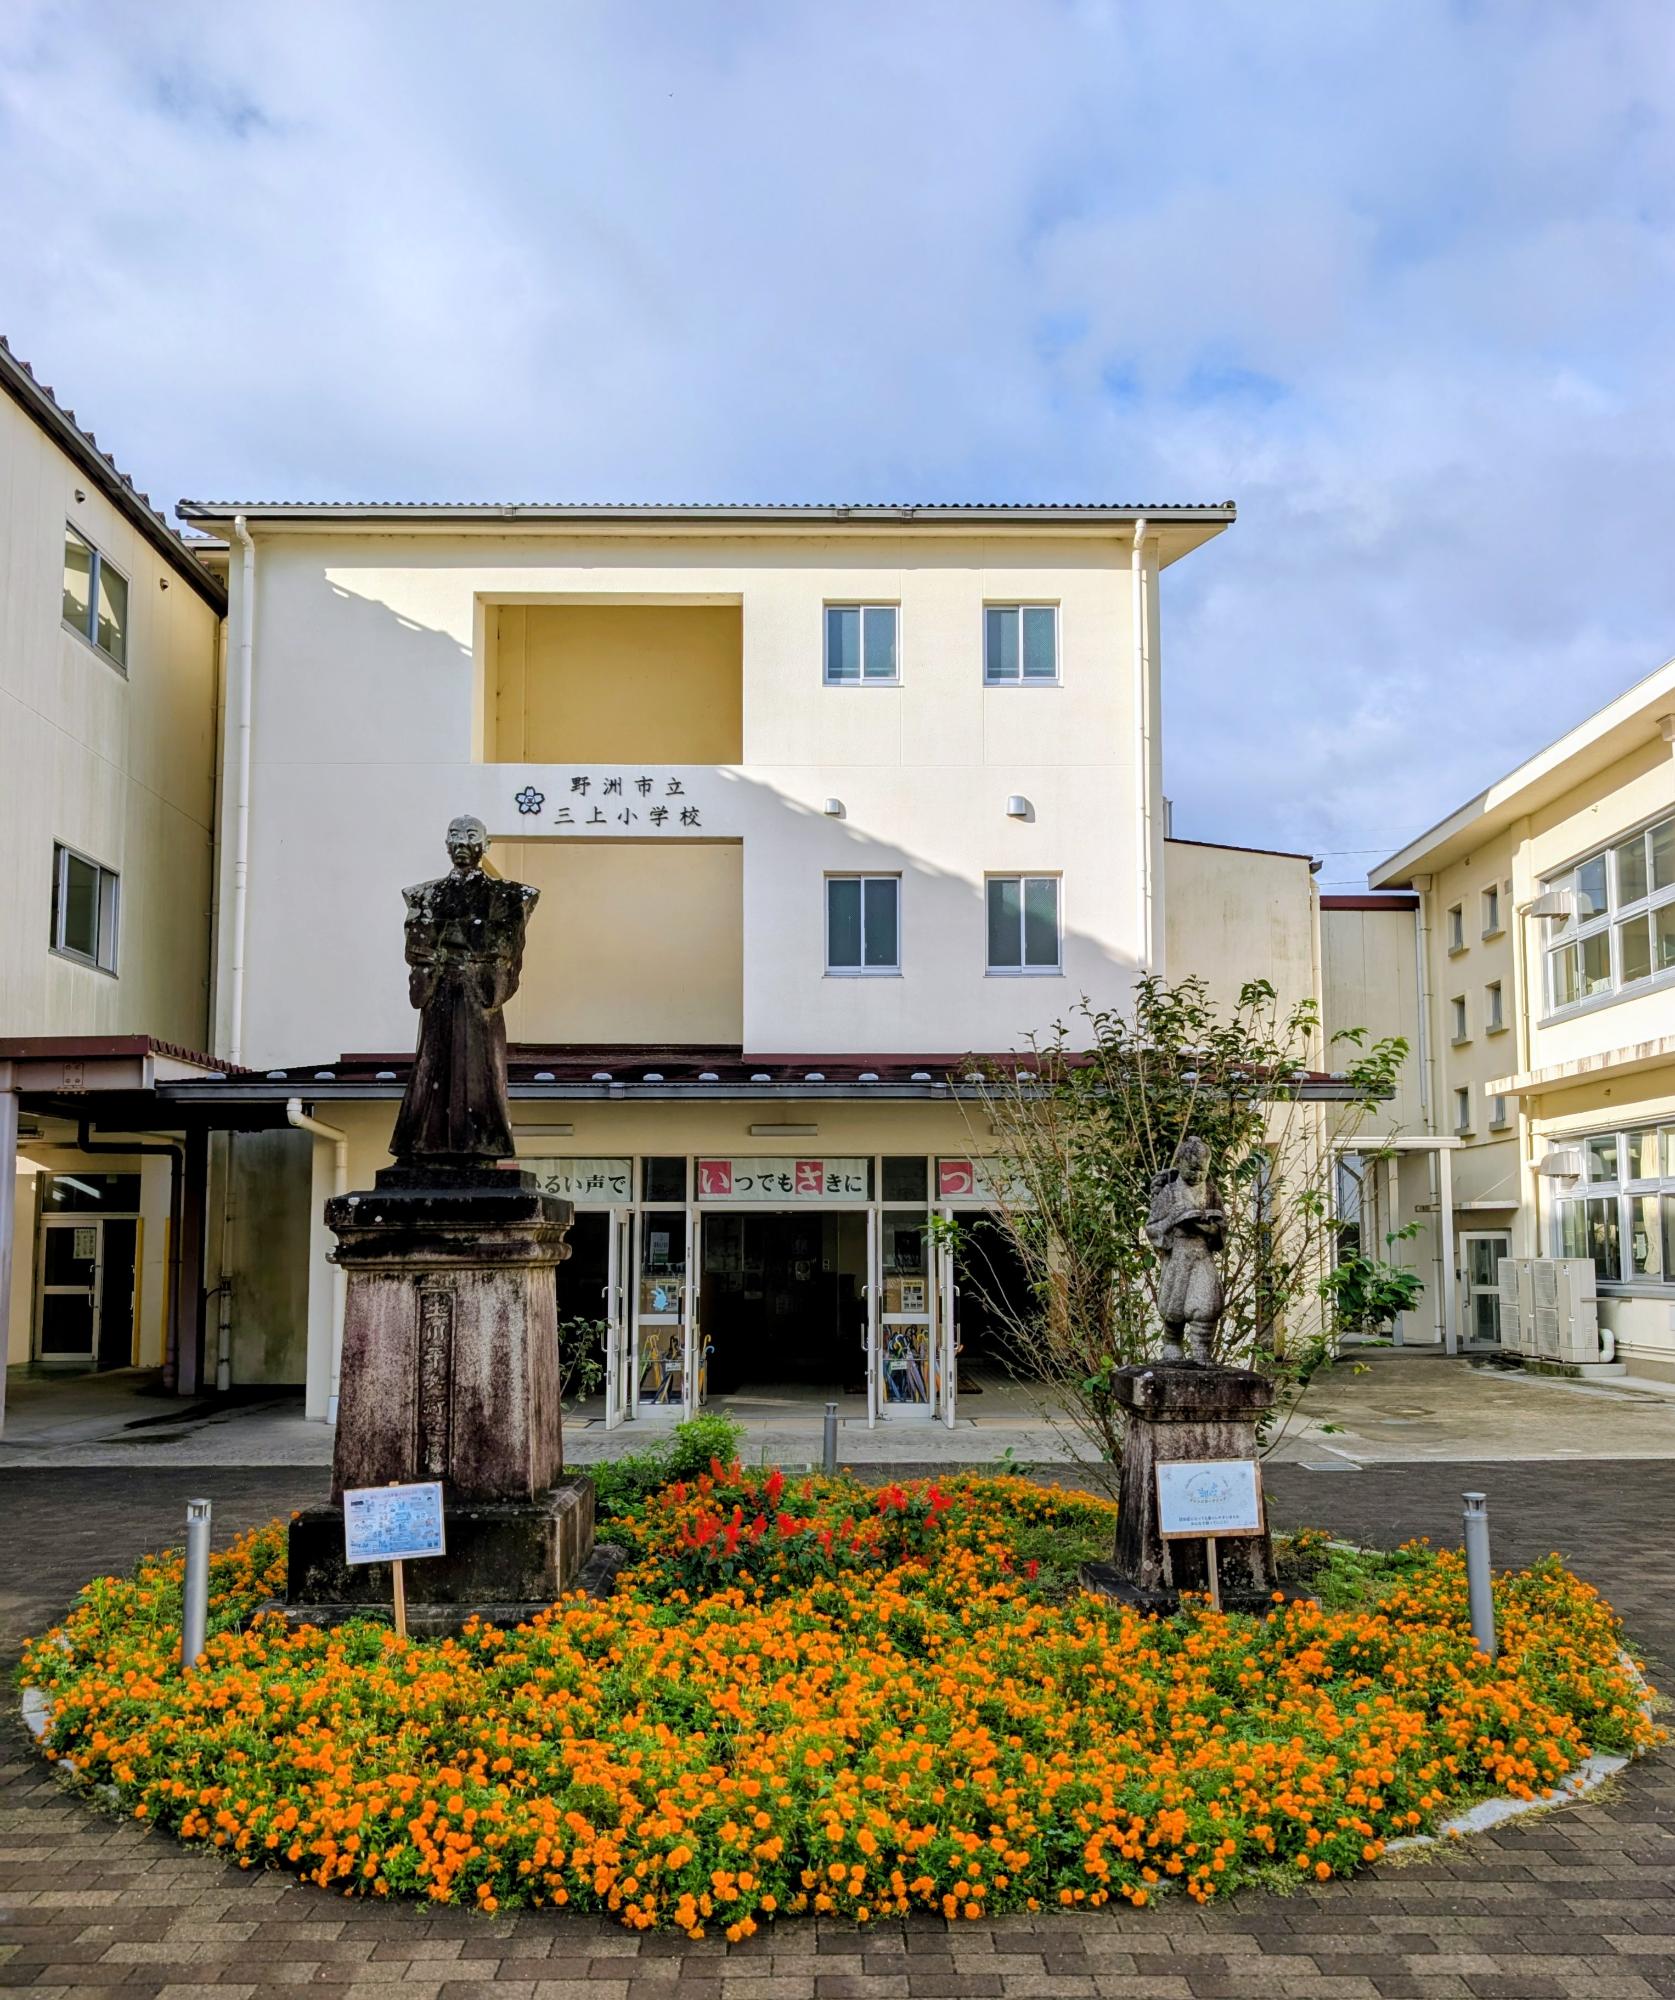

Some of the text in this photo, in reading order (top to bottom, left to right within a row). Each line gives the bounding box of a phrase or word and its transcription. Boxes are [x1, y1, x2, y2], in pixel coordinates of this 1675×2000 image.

[570, 776, 686, 797] 野洲市立
[554, 806, 702, 827] 三上小学校
[536, 1174, 627, 1194] るい声で
[701, 1166, 862, 1195] いつでもさきに
